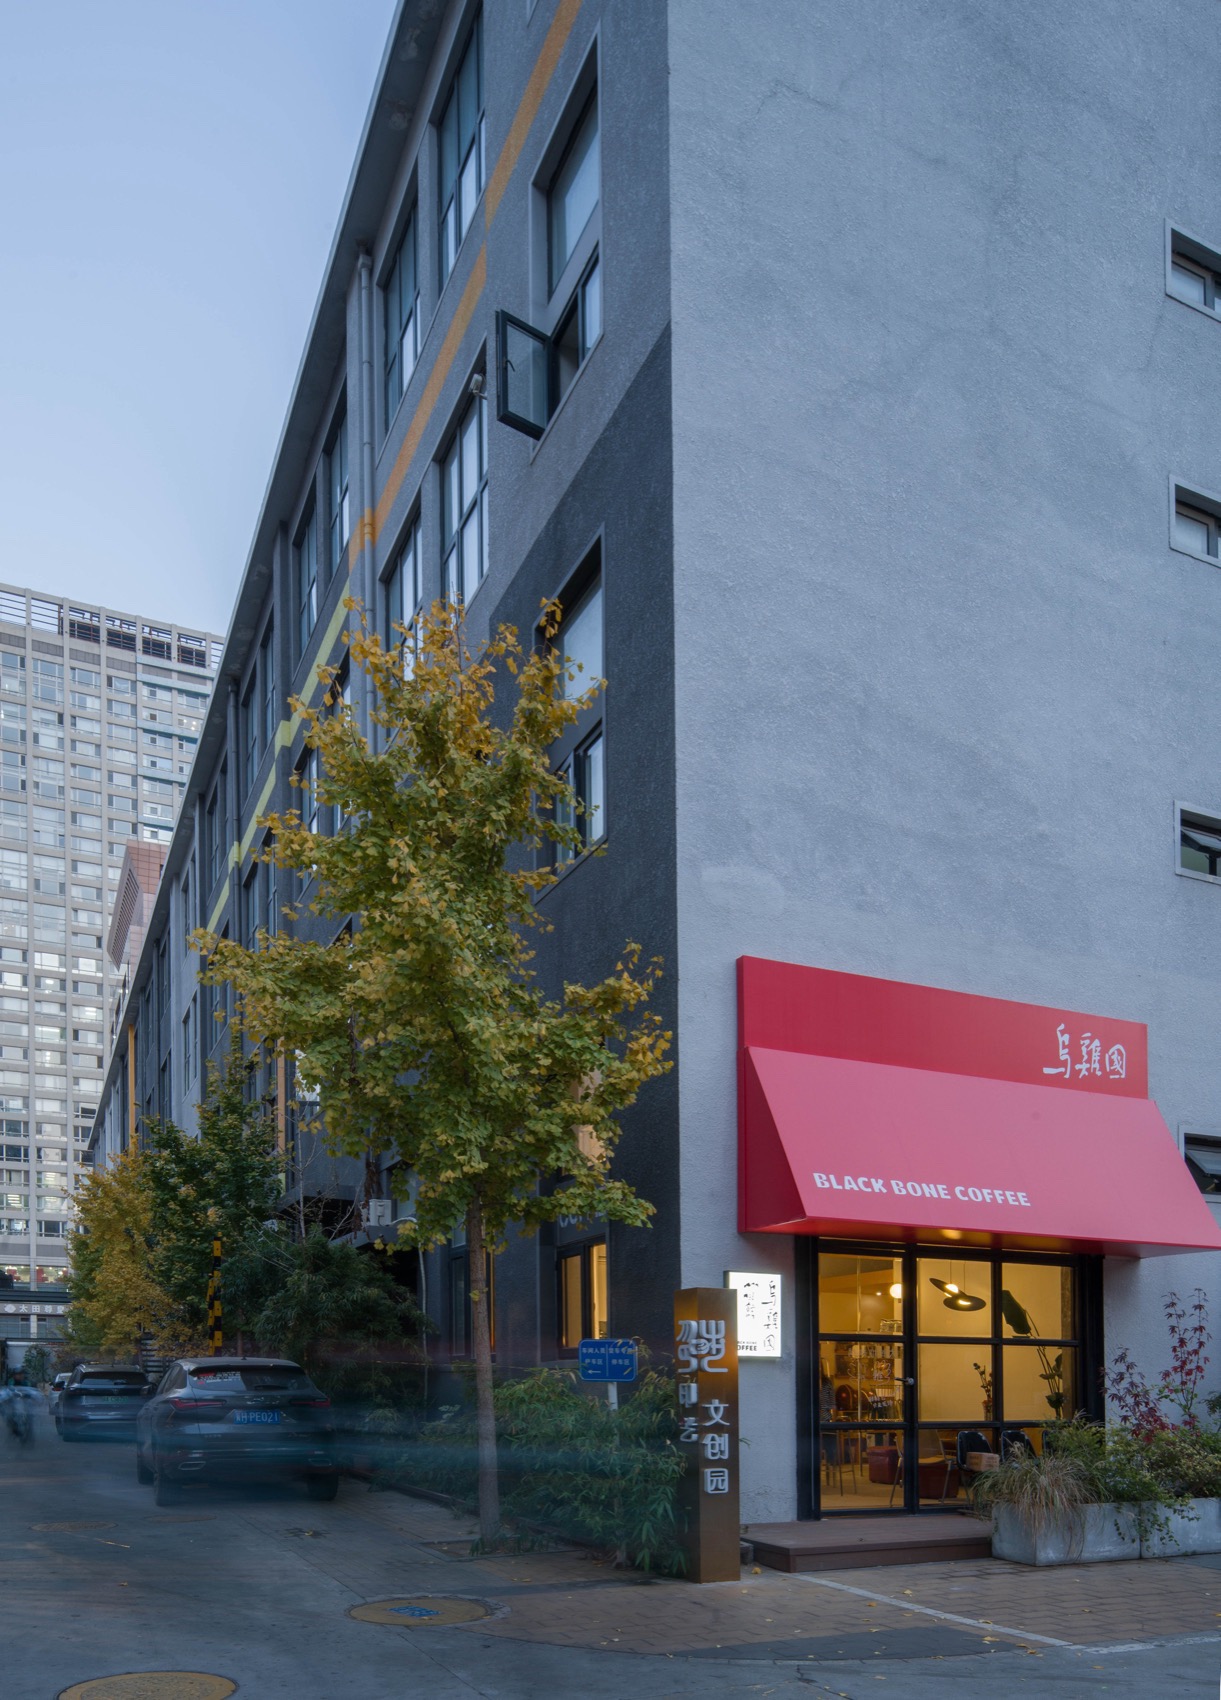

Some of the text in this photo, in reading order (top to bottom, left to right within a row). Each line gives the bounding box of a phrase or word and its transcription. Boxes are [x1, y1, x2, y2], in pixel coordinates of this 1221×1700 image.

[812, 1172, 1031, 1207] BLACK BONE COFFEE
[737, 1344, 758, 1352] OFFEE
[702, 1399, 731, 1494] 文创园
